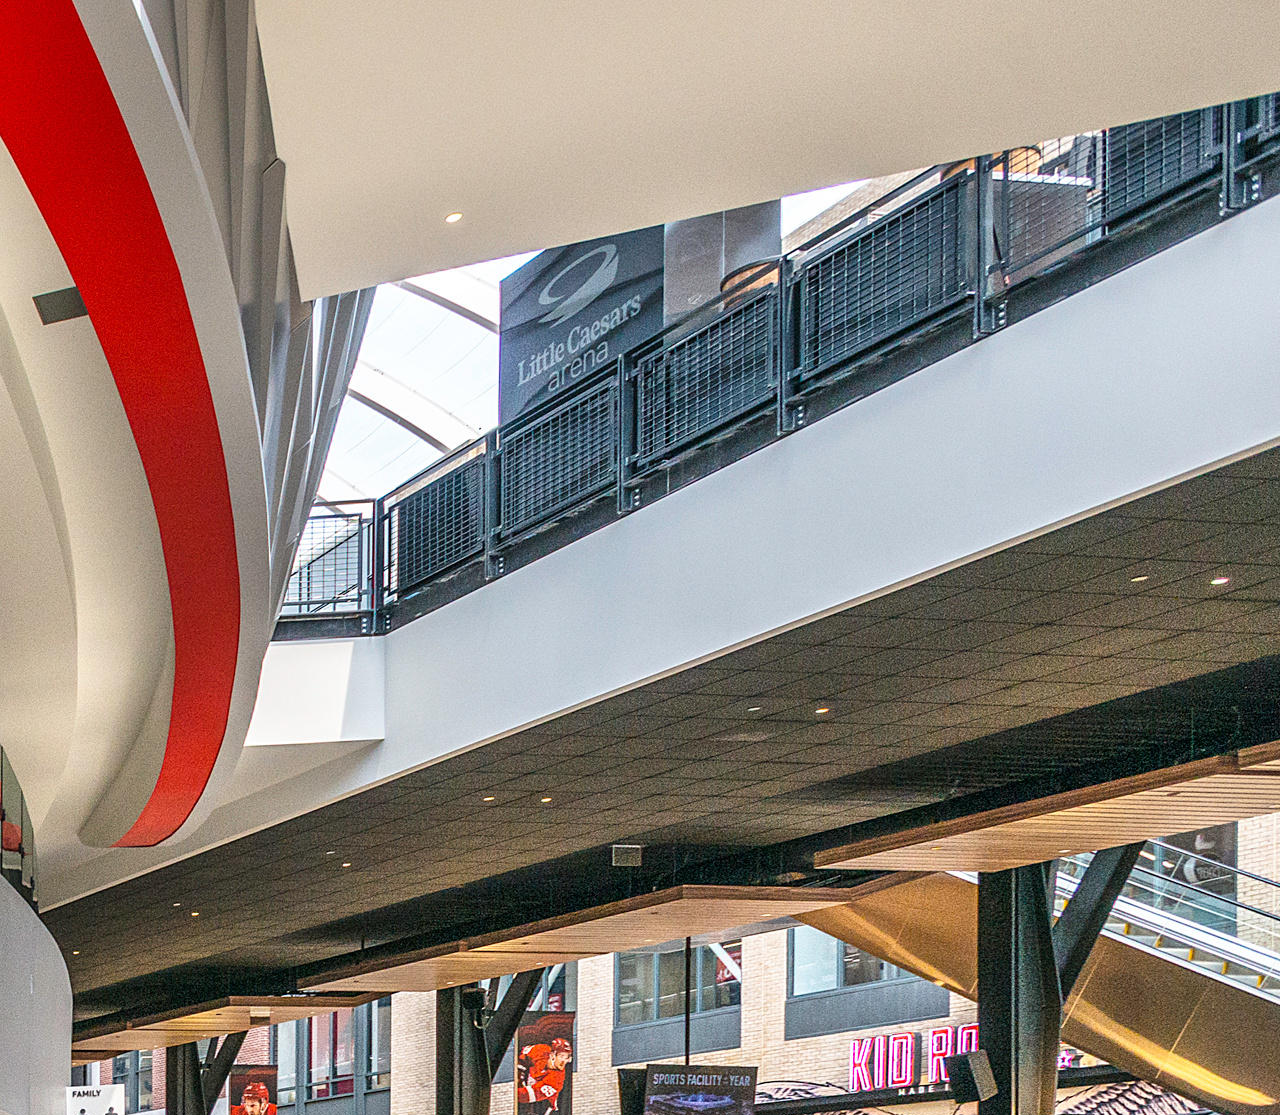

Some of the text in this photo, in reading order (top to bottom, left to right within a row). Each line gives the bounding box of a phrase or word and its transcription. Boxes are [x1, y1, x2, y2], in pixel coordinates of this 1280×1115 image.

[517, 294, 641, 387] Little Caesars
[548, 341, 609, 392] arena
[849, 1032, 916, 1093] KID
[72, 1089, 101, 1098] FAMILY
[653, 1073, 686, 1086] SPORTS
[687, 1074, 722, 1086] FACILITY
[729, 1075, 751, 1087] YEAR
[898, 1085, 936, 1096] MADE
